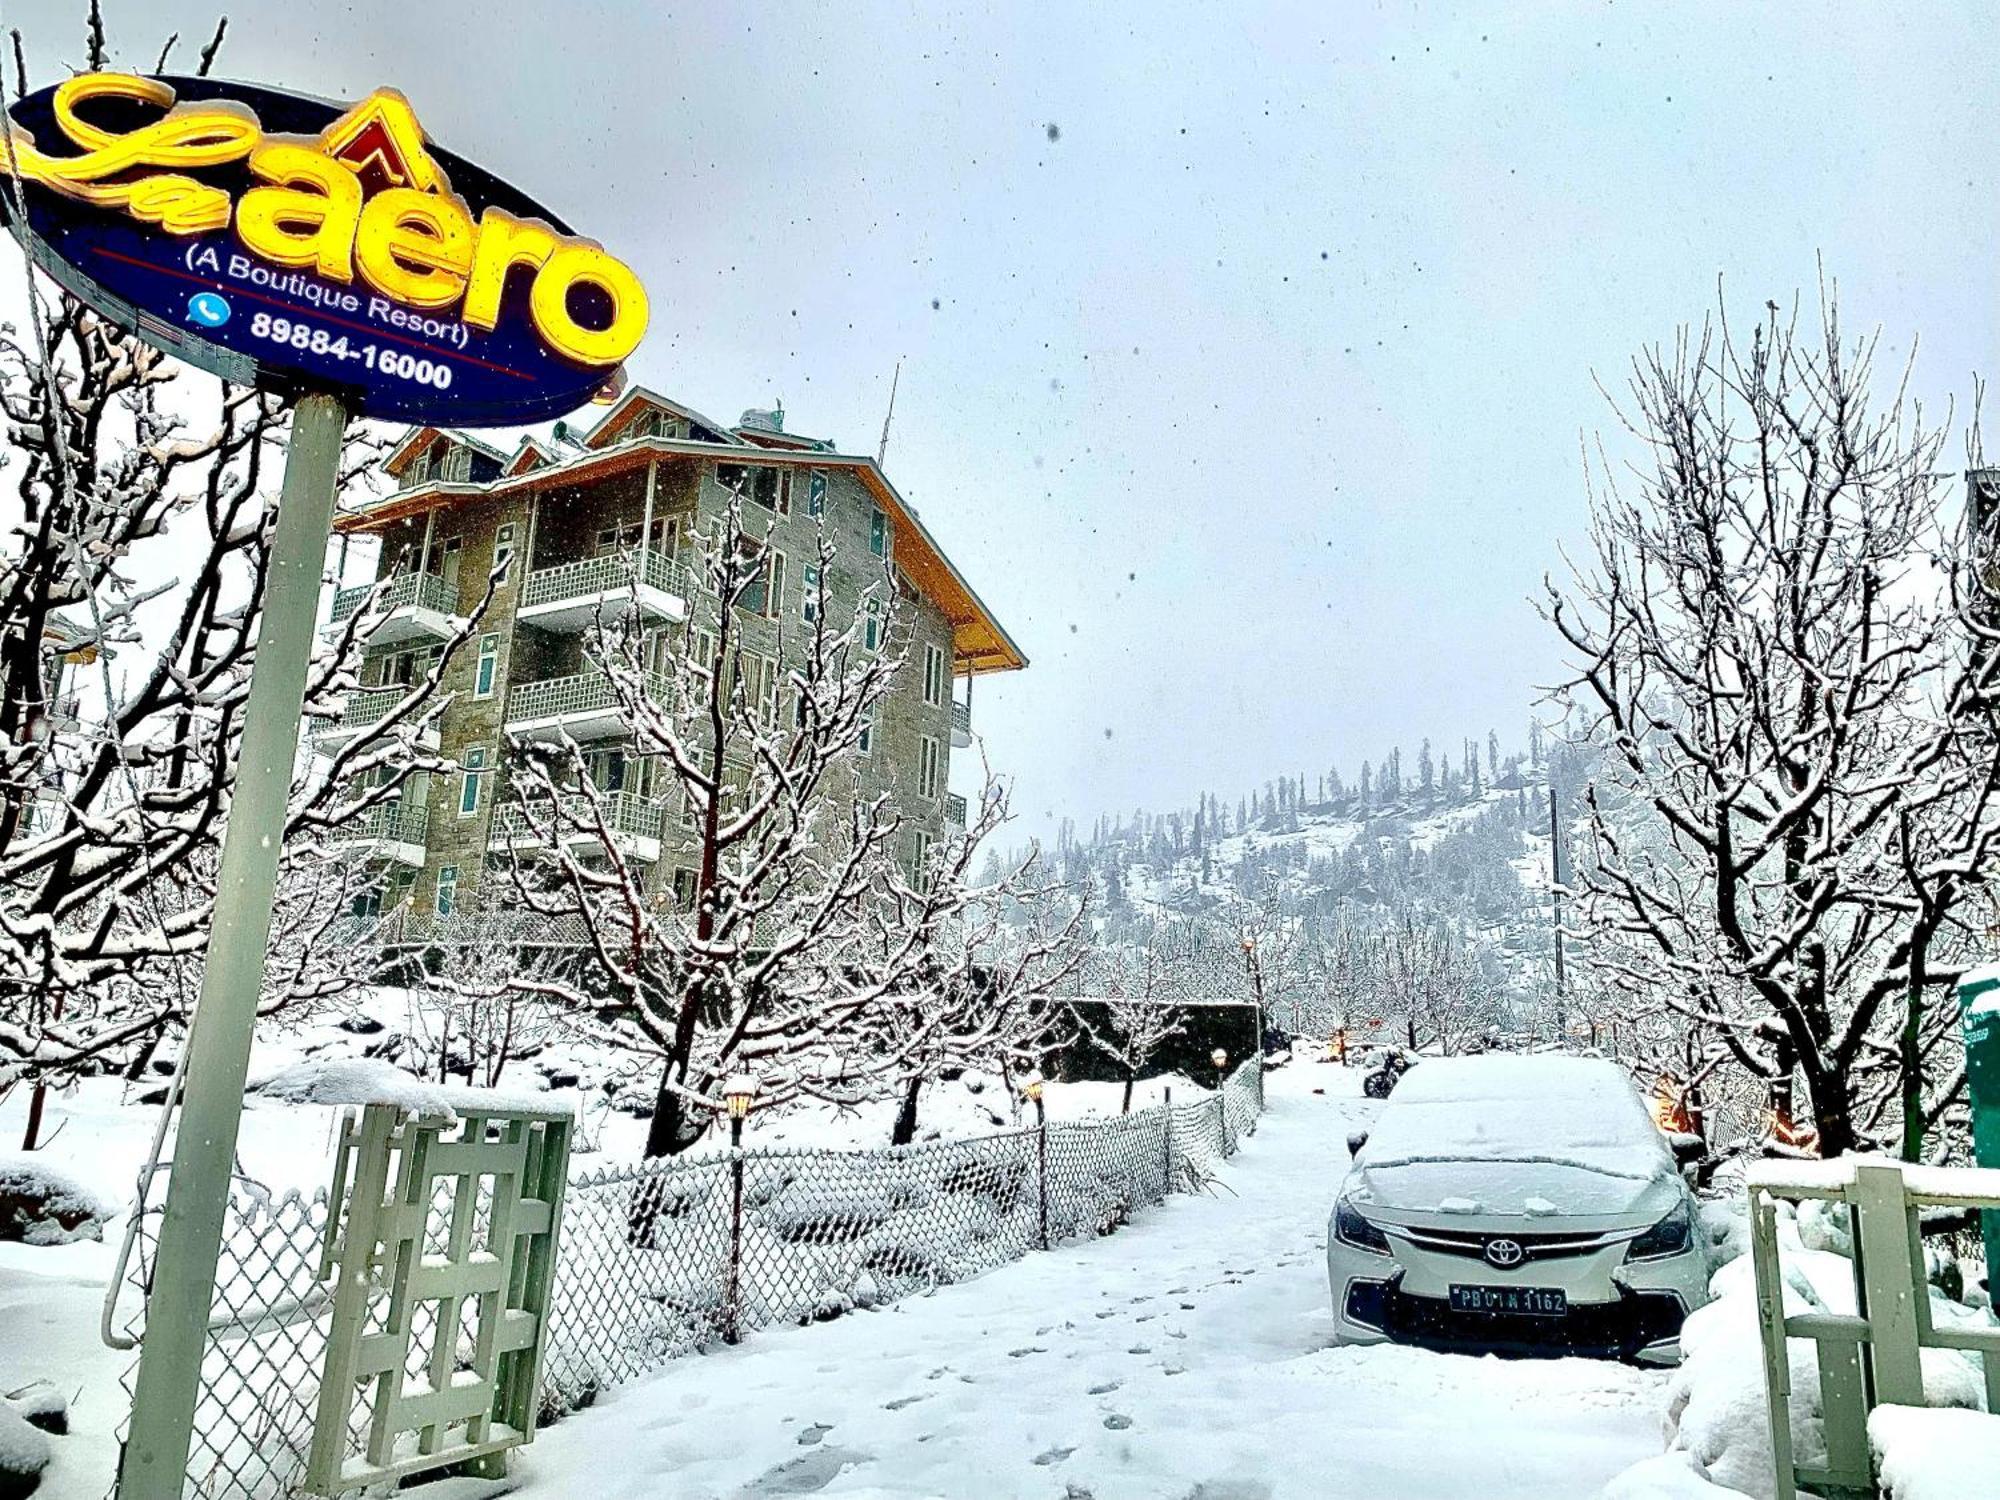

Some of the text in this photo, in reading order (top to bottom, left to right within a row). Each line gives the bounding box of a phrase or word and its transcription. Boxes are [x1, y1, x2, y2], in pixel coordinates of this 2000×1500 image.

[185, 243, 469, 350] (A Boutique Resort)
[250, 312, 453, 390] 89884-16000
